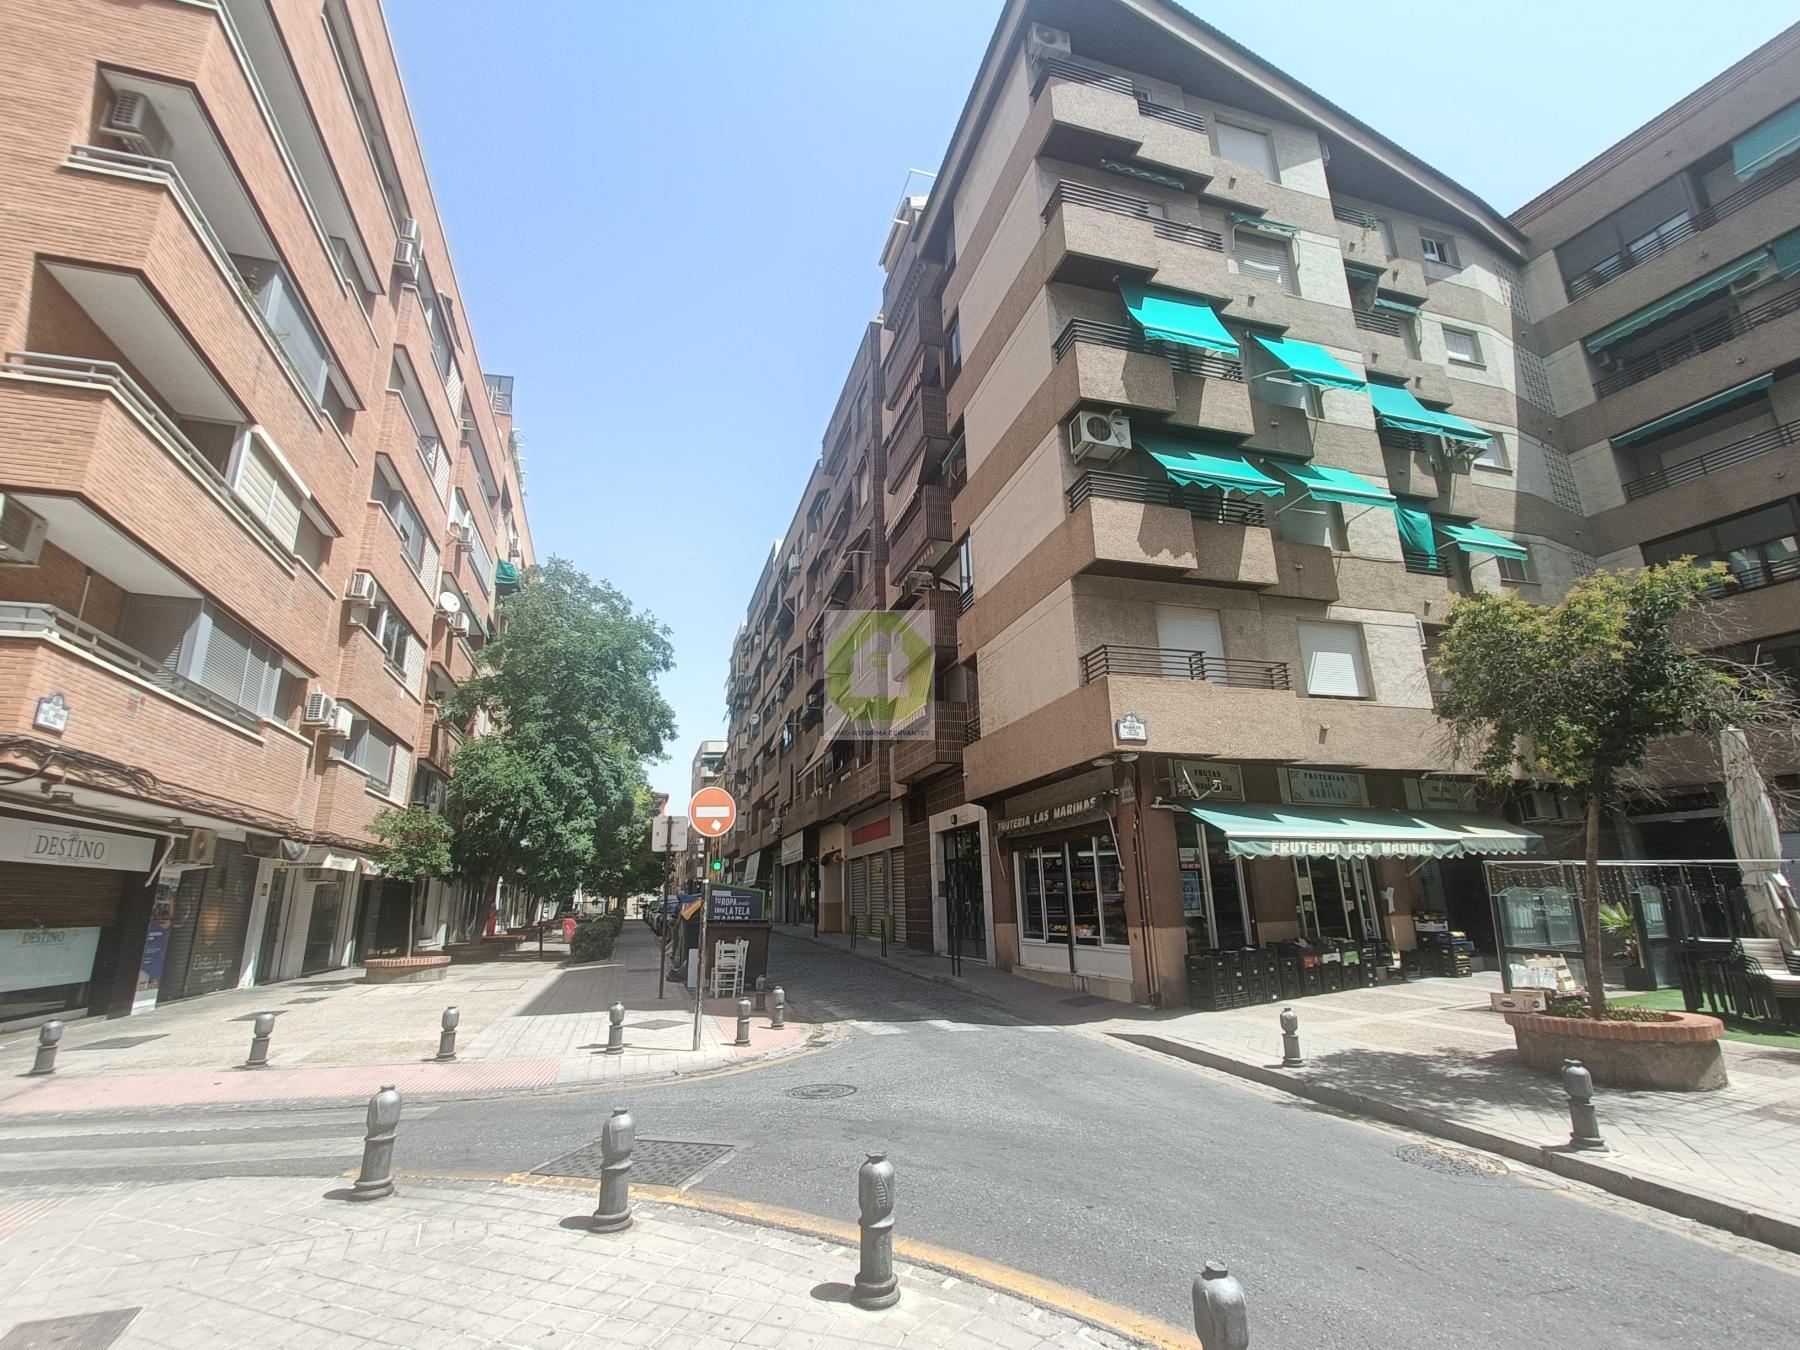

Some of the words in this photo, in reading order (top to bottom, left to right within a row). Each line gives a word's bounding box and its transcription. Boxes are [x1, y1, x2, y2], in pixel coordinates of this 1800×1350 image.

[997, 815, 1030, 833] FRUTERIA
[1033, 810, 1049, 824] LAS
[1053, 797, 1097, 819] MARINAS
[33, 835, 105, 860] DESTINO
[1271, 841, 1340, 854] FRUTERIA
[1347, 842, 1373, 854] LAS
[1381, 842, 1434, 854] MARINAS
[721, 898, 738, 906] ROPA
[725, 907, 734, 915] LA
[735, 907, 750, 915] TELA
[22, 931, 65, 945] DESTINO
